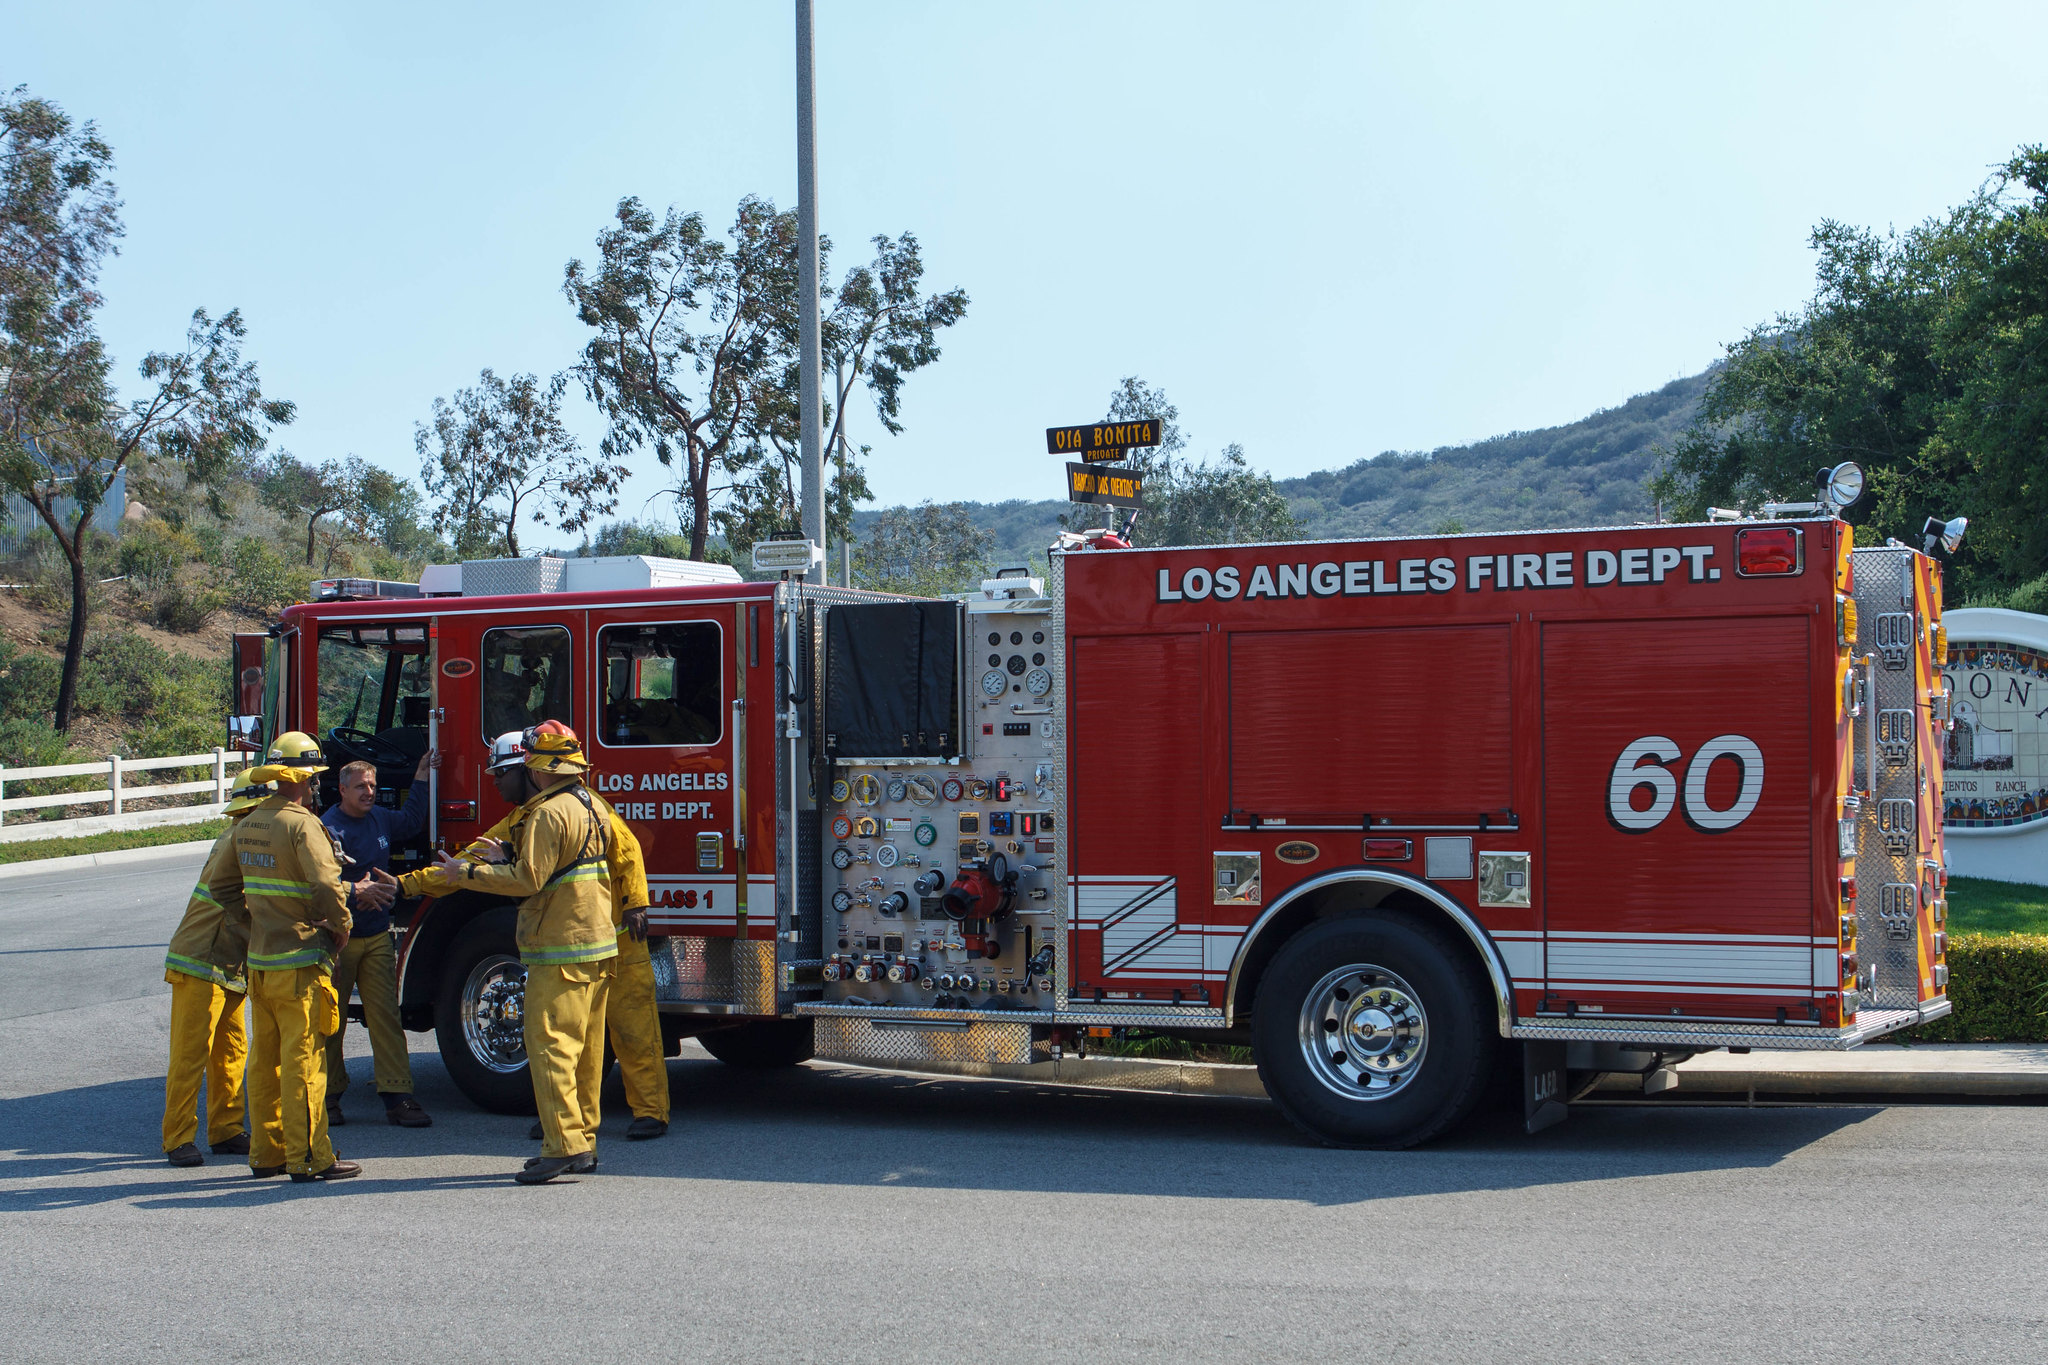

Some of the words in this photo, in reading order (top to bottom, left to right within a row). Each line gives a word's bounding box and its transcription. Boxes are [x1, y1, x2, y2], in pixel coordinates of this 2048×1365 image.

[1056, 429, 1082, 449] VIA
[1094, 423, 1151, 447] BONITA
[1087, 448, 1120, 460] PRIVATE
[1073, 472, 1095, 493] RANCHO
[1097, 475, 1109, 495] DOS
[1111, 477, 1134, 498] VIENTOS
[1157, 566, 1241, 602] LOS
[1246, 557, 1457, 598] ANGELES
[1467, 551, 1574, 592] FIRE
[1585, 545, 1721, 587] DEPT.
[1941, 672, 2048, 719] ON
[598, 774, 635, 792] LOS
[640, 772, 728, 791] ANGELES
[1605, 734, 1765, 835] 60
[1995, 781, 2027, 792] RANCH
[614, 802, 656, 820] FIRE
[662, 802, 714, 820] DEPT.
[648, 889, 698, 909] LASS
[703, 889, 713, 909] 1
